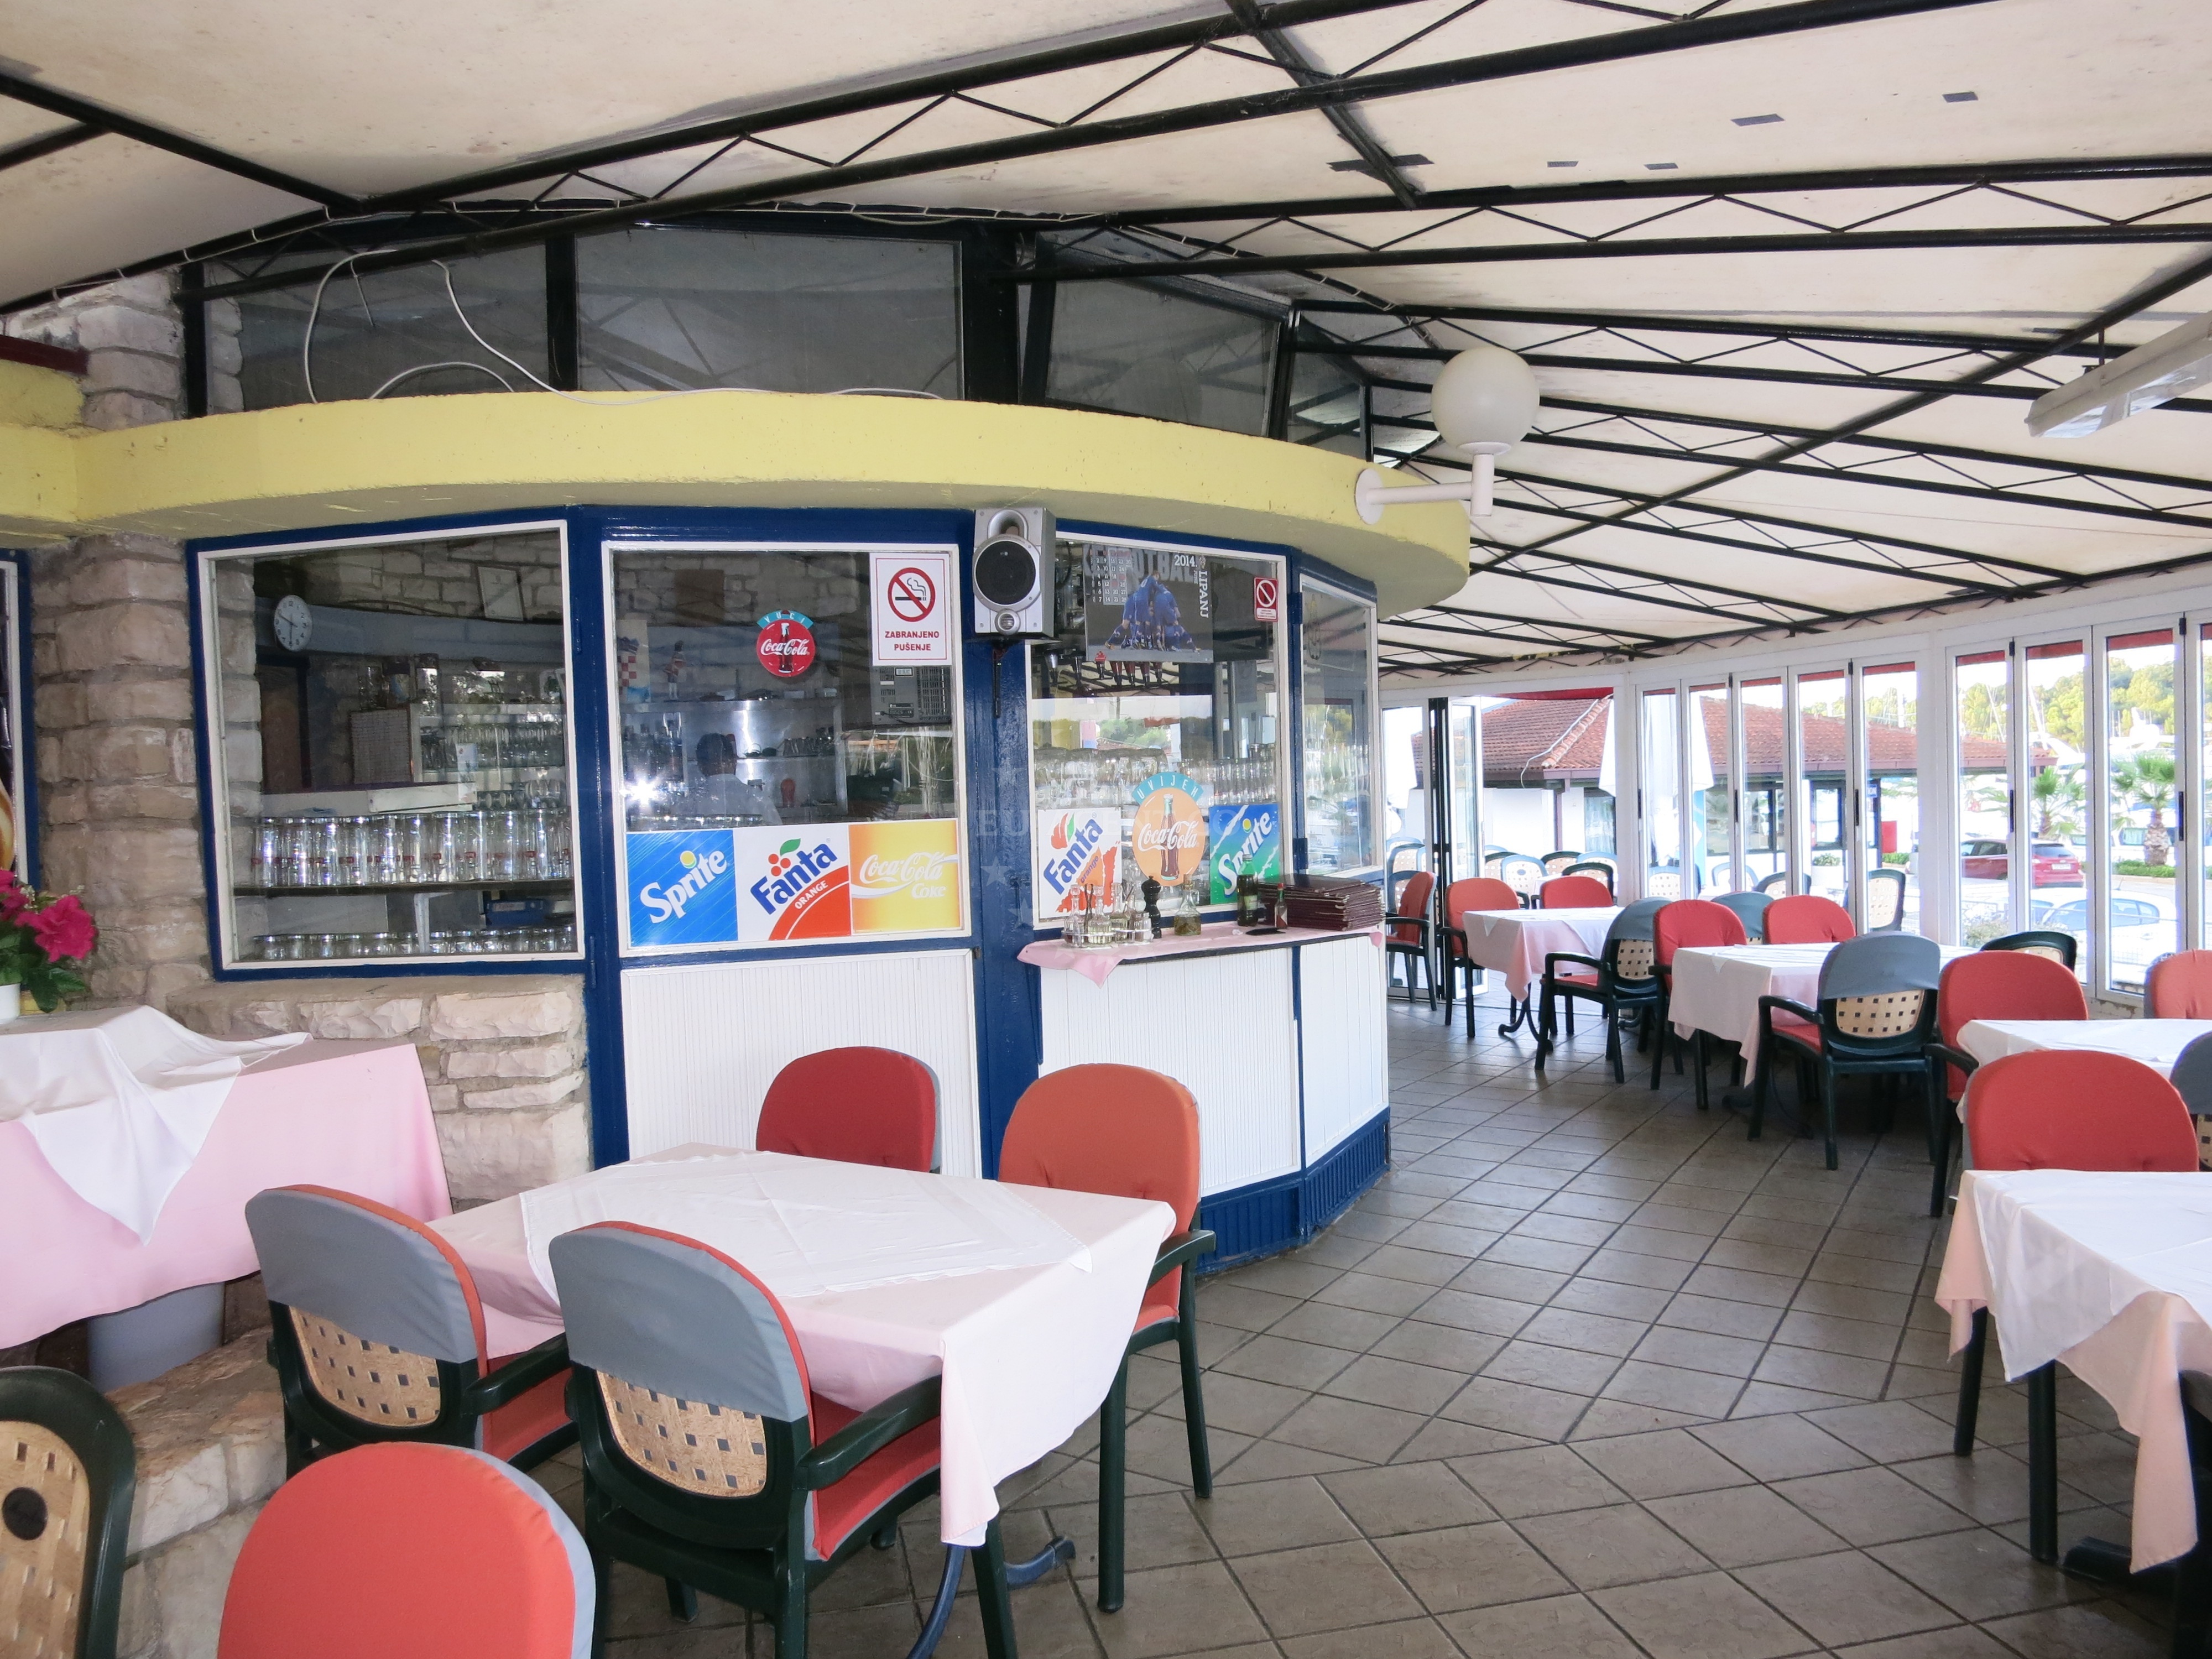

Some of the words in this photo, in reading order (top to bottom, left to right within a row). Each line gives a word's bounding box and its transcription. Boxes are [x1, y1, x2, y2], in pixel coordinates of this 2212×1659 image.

[1174, 554, 1198, 567] 2014.
[1198, 570, 1209, 618] LIPANJ
[760, 638, 810, 656] Coca-Cola
[894, 642, 931, 651] PUŠENJE
[1138, 820, 1199, 852] Coca-Cola
[859, 851, 945, 884] Coca-Cola
[1043, 818, 1104, 895] Fanta
[1080, 855, 1099, 884] orange
[640, 850, 728, 924] Sprite
[750, 843, 838, 915] Fanta
[795, 880, 829, 910] ORANGE
